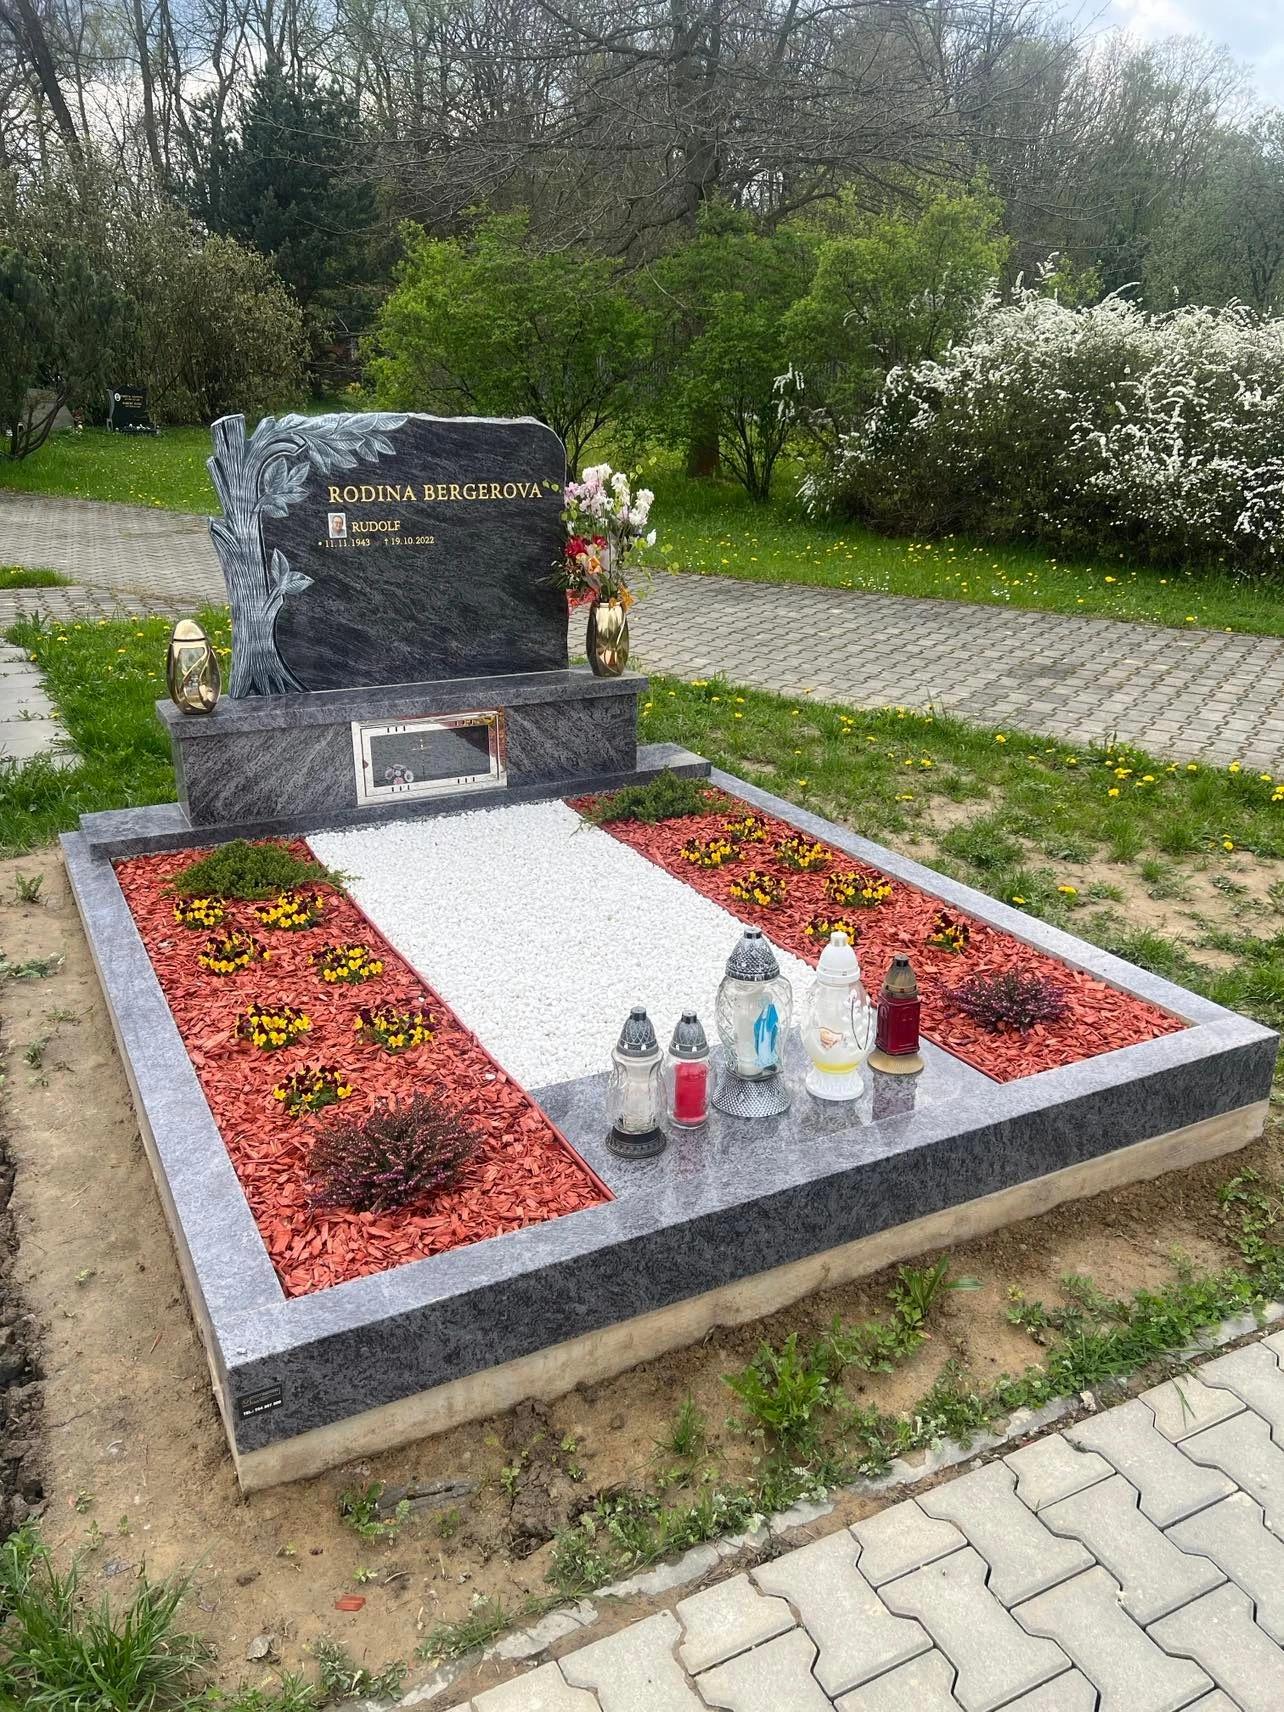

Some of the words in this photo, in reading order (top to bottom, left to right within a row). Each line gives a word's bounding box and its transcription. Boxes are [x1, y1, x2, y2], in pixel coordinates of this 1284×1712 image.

[328, 486, 417, 503] RODINA
[423, 483, 542, 501] BERGEROVA
[352, 520, 401, 533] RUDOLF
